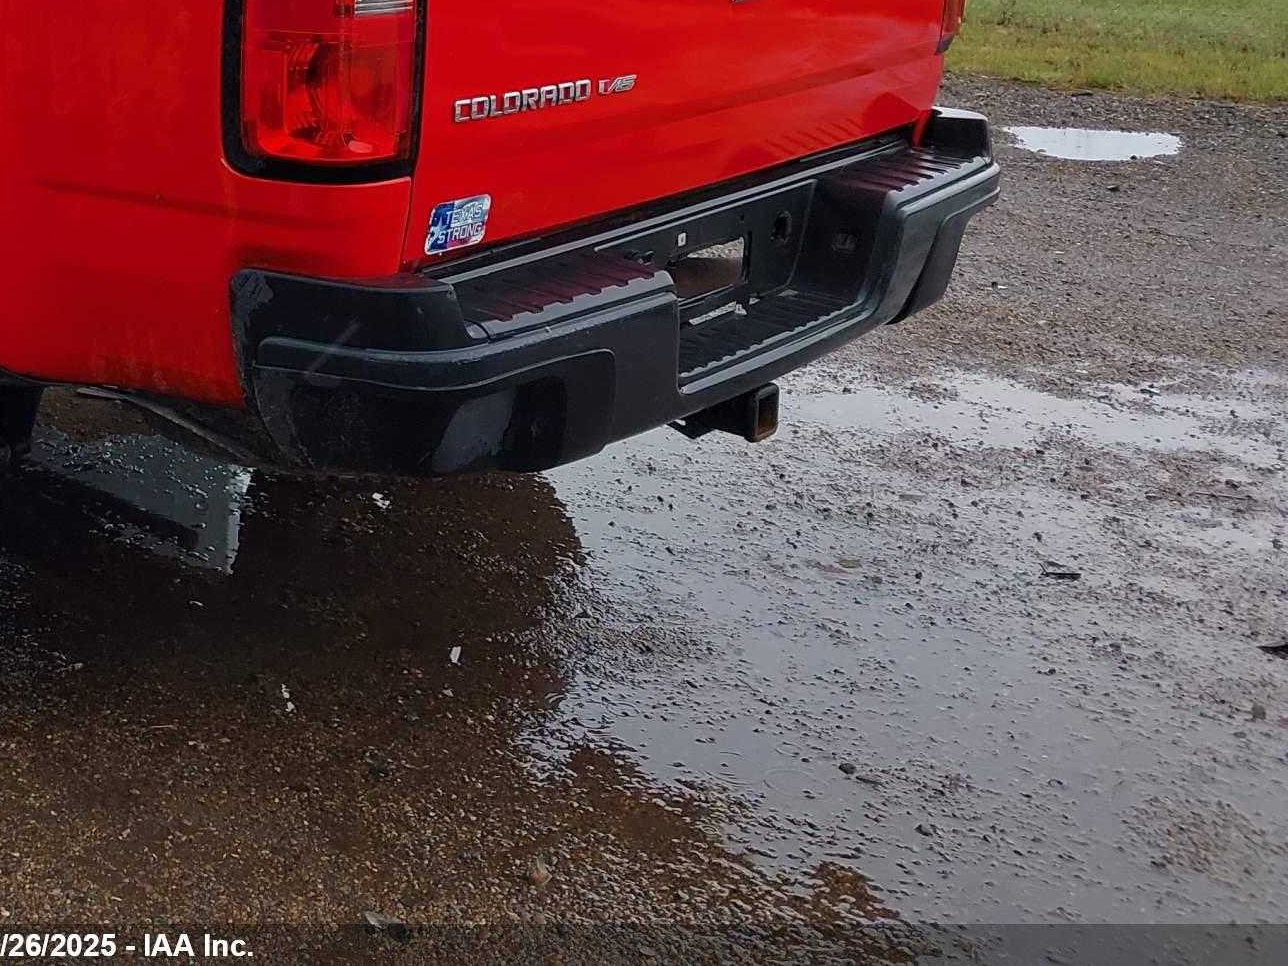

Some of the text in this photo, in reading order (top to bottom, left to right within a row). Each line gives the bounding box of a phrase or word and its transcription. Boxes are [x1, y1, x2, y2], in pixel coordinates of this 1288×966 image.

[454, 74, 638, 123] COLORADO V6
[446, 203, 483, 225] TEXAS
[437, 222, 483, 244] STRONG
